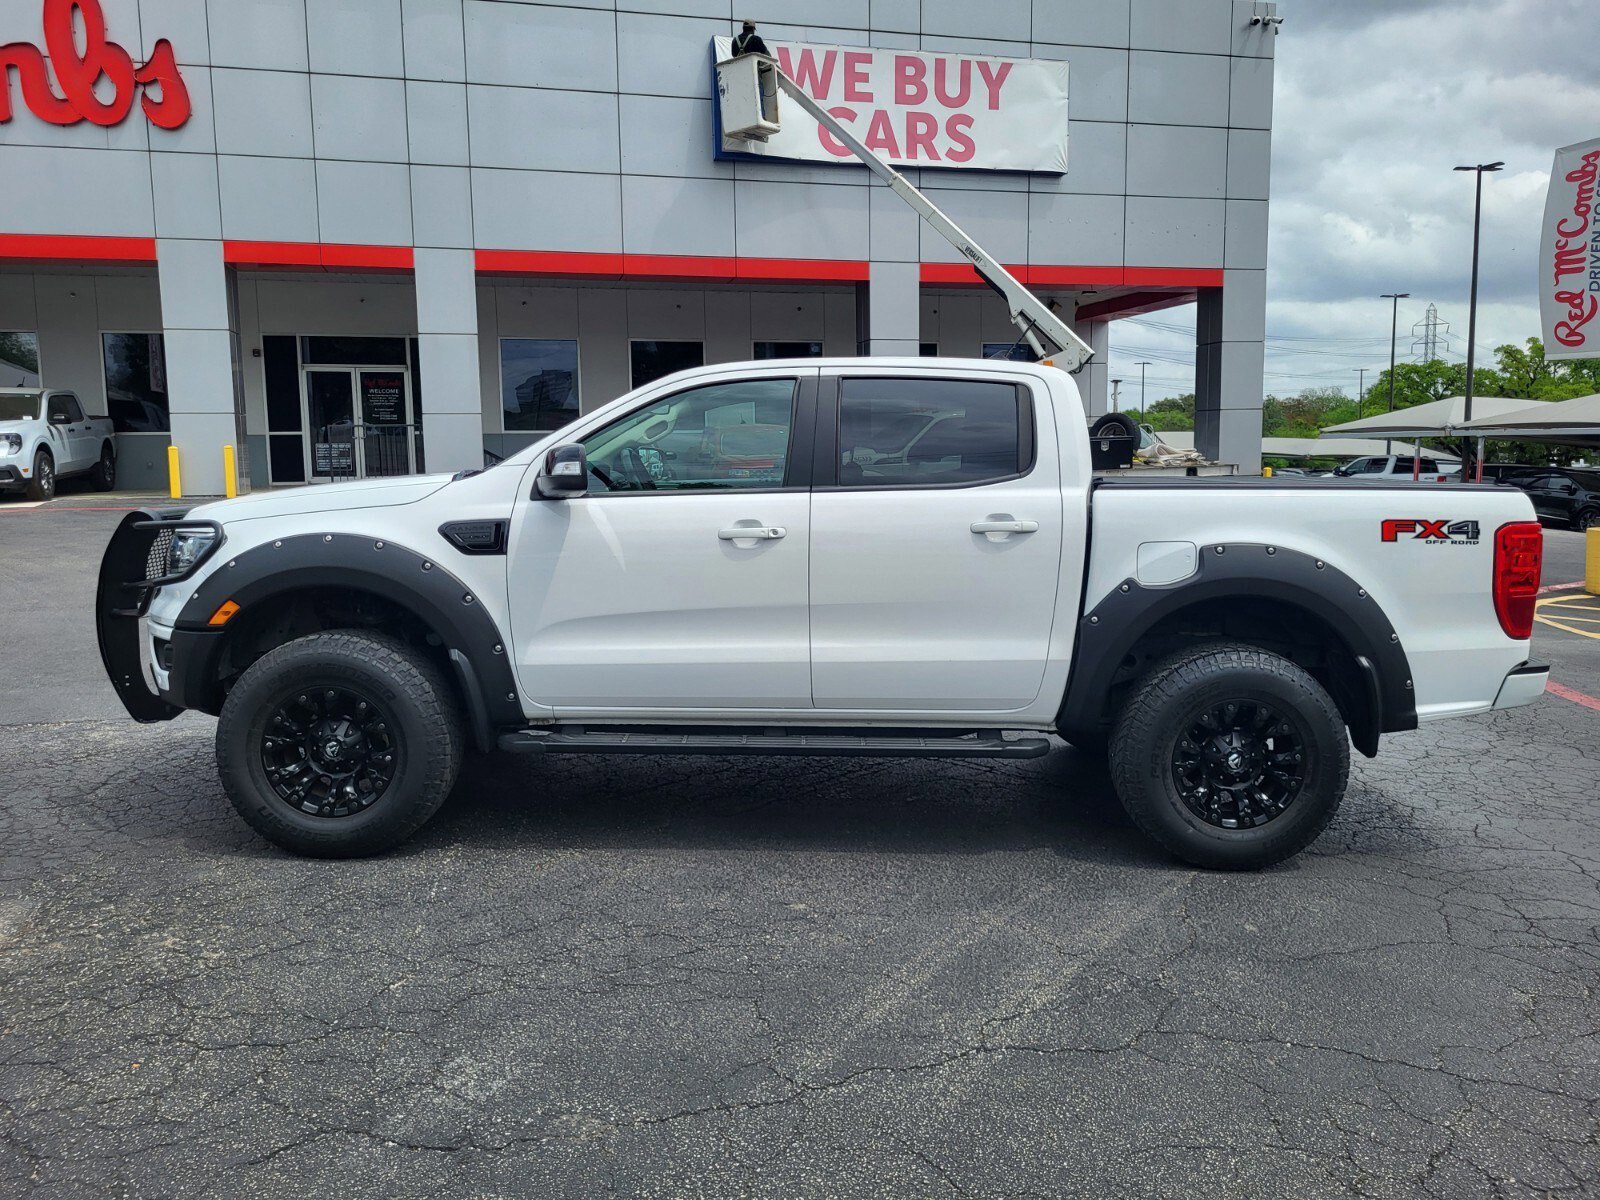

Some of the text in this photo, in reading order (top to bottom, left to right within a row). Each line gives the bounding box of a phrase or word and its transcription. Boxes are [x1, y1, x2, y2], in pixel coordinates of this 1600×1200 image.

[776, 46, 1014, 111] WE BUY
[817, 106, 976, 163] CARS
[1553, 150, 1600, 348] Red McCombs
[1589, 230, 1600, 292] DRIVEN
[1381, 519, 1480, 542] FX4
